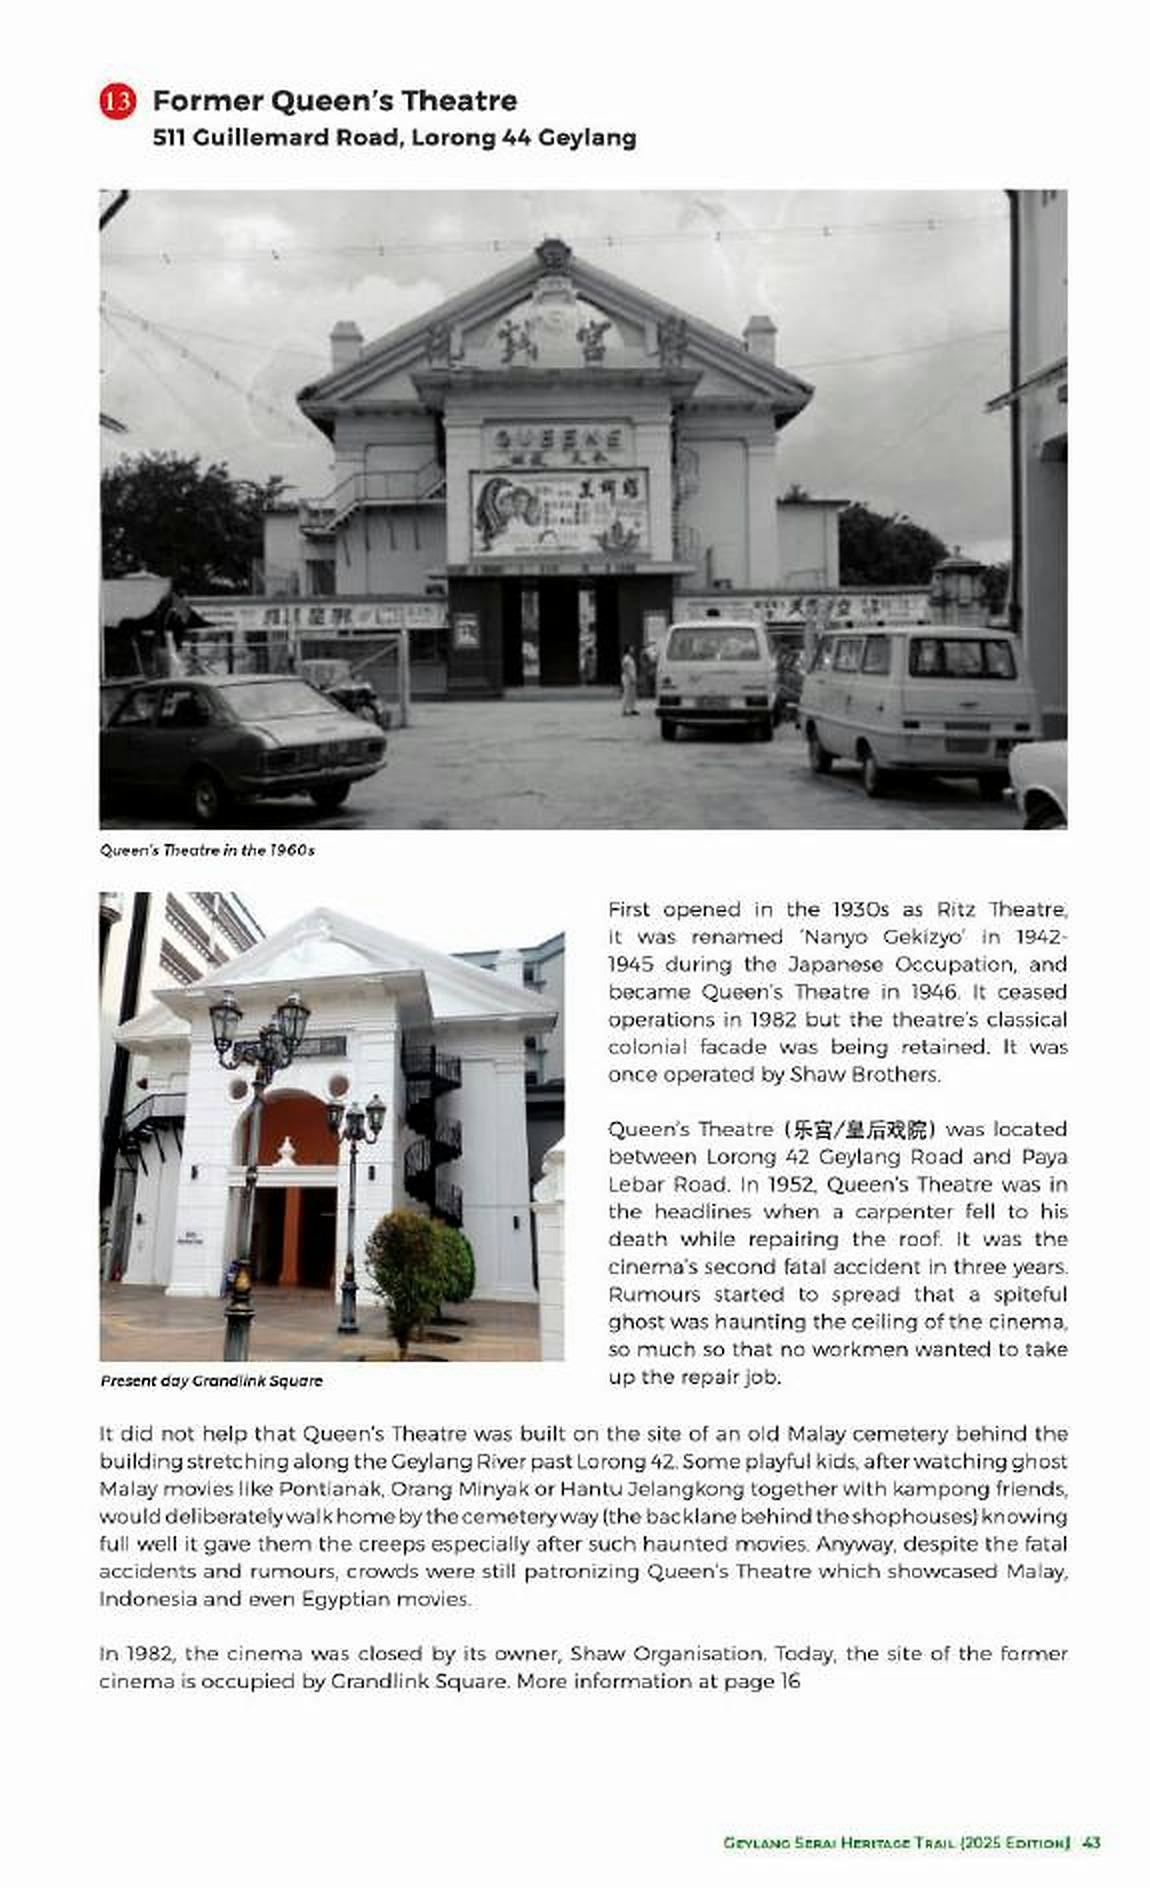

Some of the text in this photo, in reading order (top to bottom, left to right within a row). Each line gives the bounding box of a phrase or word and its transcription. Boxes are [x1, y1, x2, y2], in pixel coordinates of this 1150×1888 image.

[106, 91, 131, 111] 13
[153, 89, 265, 112] Former
[400, 88, 518, 112] Theatre
[152, 126, 637, 152] 511 Guillemard Road, Lorong 44 Geylang
[163, 843, 221, 857] Theatre
[223, 843, 238, 857] in
[241, 843, 267, 857] the
[271, 843, 315, 857] 1960s
[609, 900, 1068, 921] First opened in the 1930s as Ritz Theatre,
[637, 931, 676, 945] was
[692, 928, 783, 945] renamed
[982, 932, 1001, 944] in
[1016, 929, 1067, 945] 1942-
[607, 955, 1068, 977] 1945 during the Japanese Occupation, and
[609, 984, 691, 1001] became
[794, 983, 870, 1000] Theatre
[881, 983, 900, 1000] in
[911, 983, 961, 1001] 1946.
[973, 984, 986, 1000] It
[997, 983, 1068, 1001] ceased
[608, 1011, 716, 1031] operations
[724, 1011, 742, 1027] in
[751, 1011, 797, 1028] 1982
[805, 1011, 841, 1028] but
[849, 1011, 883, 1028] the
[986, 1010, 1068, 1028] classical
[607, 1037, 1069, 1059] colonial facade was being retained. It was
[608, 1065, 941, 1087] once operated by Shaw Brothers.
[698, 1120, 774, 1137] Theatre
[945, 1125, 985, 1137] was
[993, 1120, 1068, 1137] located
[609, 1147, 1068, 1169] between Lorong 42 Geylang Road and Paya
[609, 1176, 665, 1193] Lebar
[674, 1175, 731, 1193] Road.
[741, 1177, 759, 1192] In
[768, 1175, 818, 1194] 1952,
[917, 1175, 993, 1193] Theatre
[1001, 1179, 1041, 1193] was
[1049, 1175, 1068, 1193] in
[608, 1202, 1069, 1224] the headlines when a carpenter fell to his
[100, 1375, 324, 1391] Present day Grandlink Square
[100, 1426, 113, 1442] It
[120, 1425, 153, 1442] did
[161, 1427, 195, 1442] not
[203, 1425, 248, 1445] help
[254, 1425, 296, 1443] that
[392, 1424, 467, 1443] Theatre
[473, 1429, 513, 1442] was
[520, 1424, 566, 1442] built
[573, 1429, 599, 1442] on
[606, 1425, 641, 1442] the
[647, 1425, 682, 1443] site
[688, 1425, 709, 1442] of
[715, 1429, 741, 1442] an
[747, 1425, 780, 1443] old
[788, 1425, 847, 1446] Malay
[852, 1427, 949, 1446] cemetery
[956, 1424, 1027, 1443] behind
[1035, 1425, 1069, 1442] the
[99, 1563, 197, 1579] accidents
[203, 1563, 242, 1579] and
[250, 1567, 339, 1580] rumours,
[346, 1563, 419, 1579] crowds
[425, 1567, 476, 1579] were
[482, 1563, 516, 1579] still
[524, 1563, 640, 1584] patronizing
[735, 1563, 813, 1579] Theatre
[818, 1563, 881, 1579] which
[887, 1564, 998, 1579] showcased
[1007, 1563, 1069, 1584] Malay,
[100, 1589, 473, 1611] Indonesia and even Egyptian movies.
[99, 1671, 801, 1693] cinema is occupied by Grandlink Square. More information at page 16
[1081, 1836, 1101, 1849] 43
